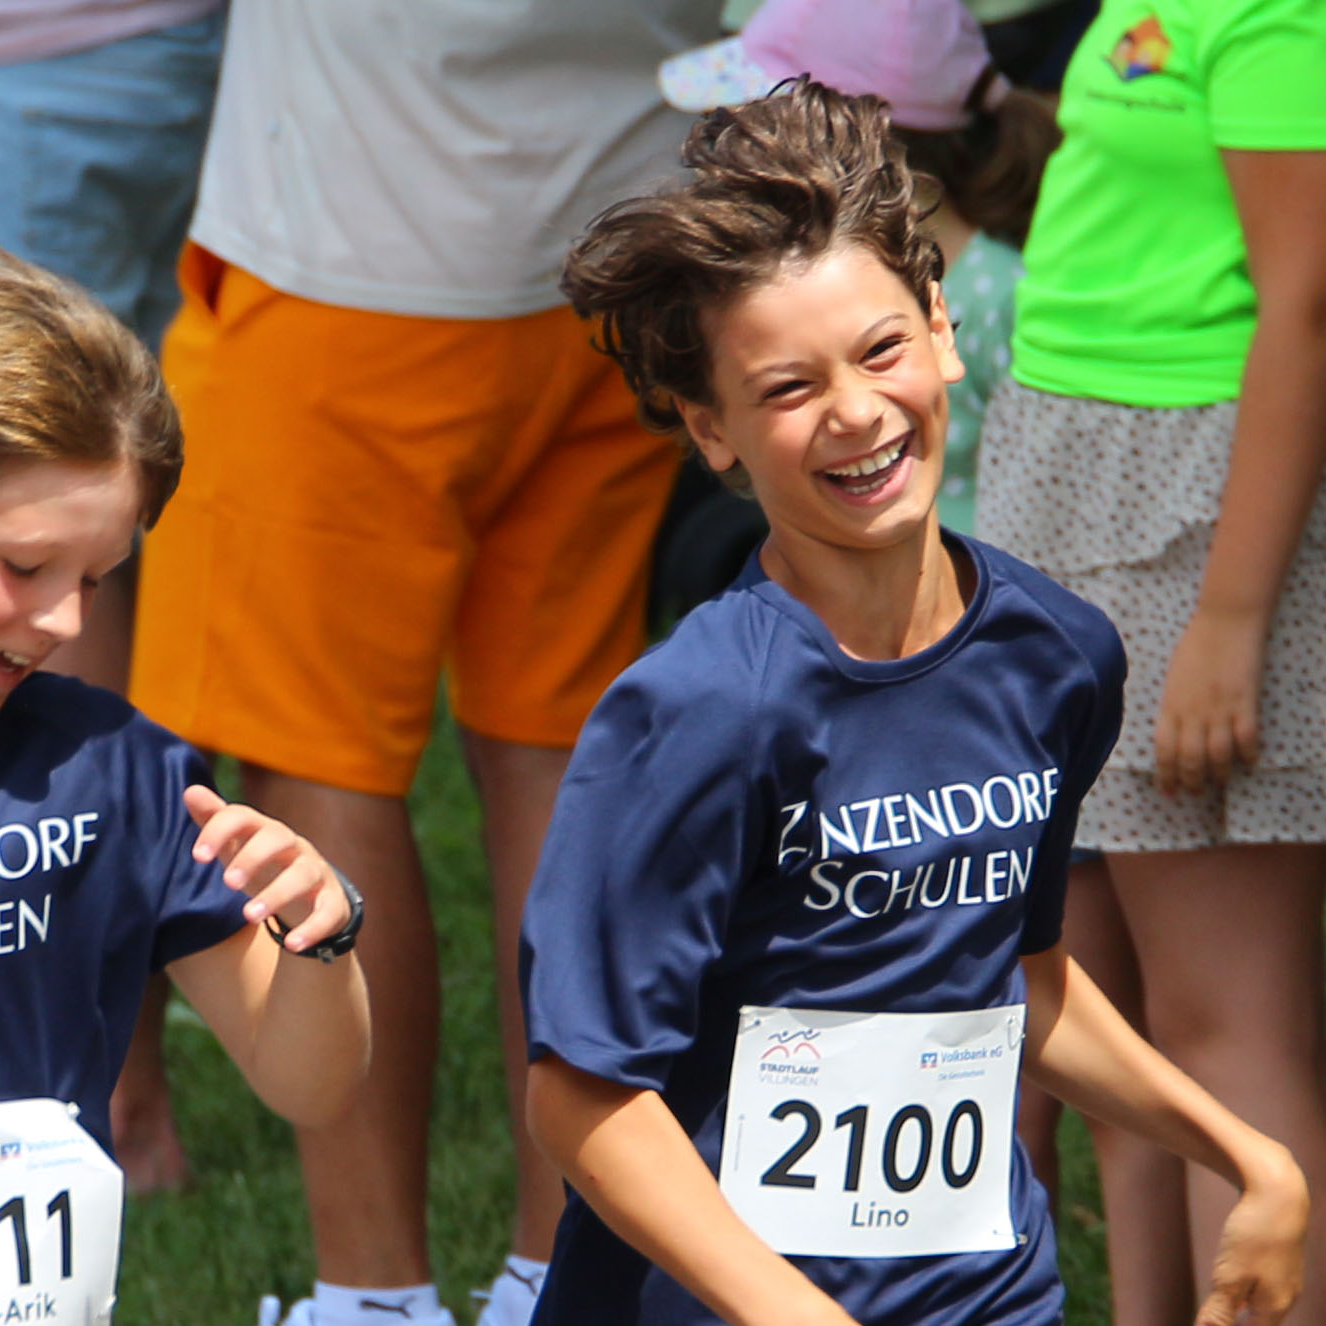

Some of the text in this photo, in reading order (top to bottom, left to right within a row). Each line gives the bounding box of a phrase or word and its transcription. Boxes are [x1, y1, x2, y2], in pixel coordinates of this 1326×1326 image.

[777, 767, 1059, 867] ZNZENDORF
[803, 846, 1033, 919] SCHULEN
[759, 1063, 820, 1075] STADTLAUF
[940, 1048, 988, 1064] Volksbank
[759, 1098, 984, 1194] 2100
[850, 1202, 910, 1228] Lino
